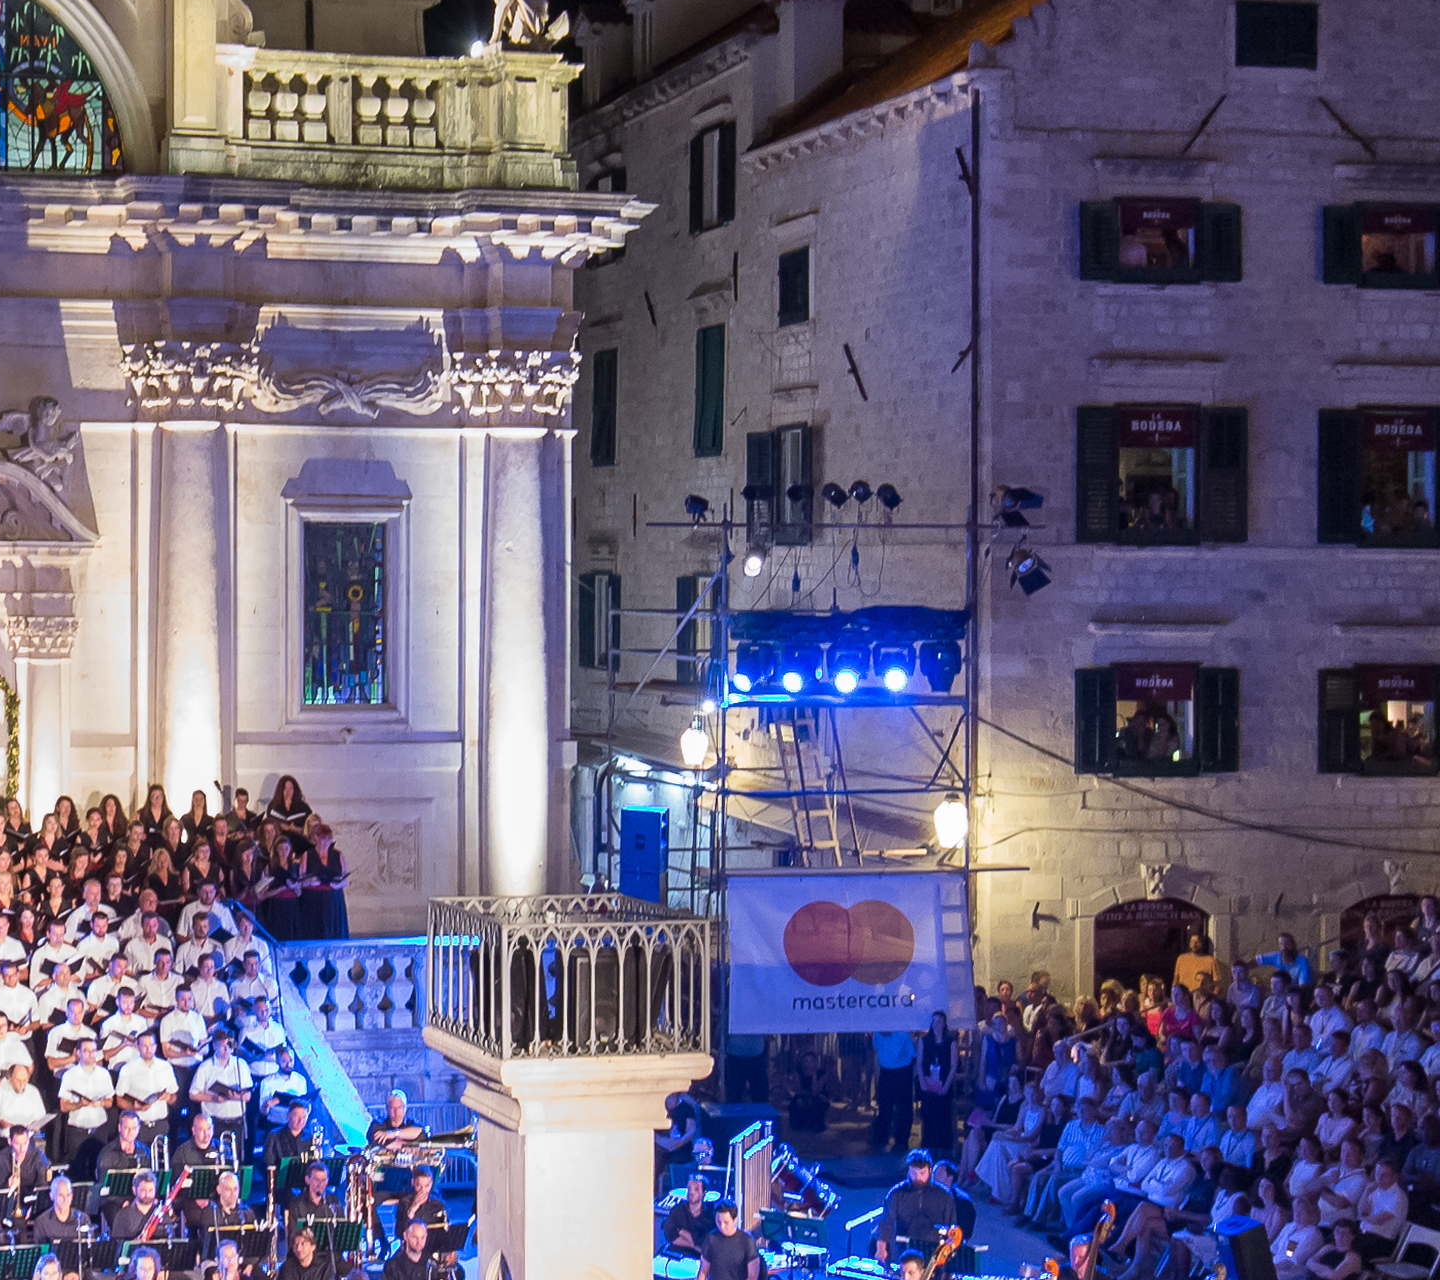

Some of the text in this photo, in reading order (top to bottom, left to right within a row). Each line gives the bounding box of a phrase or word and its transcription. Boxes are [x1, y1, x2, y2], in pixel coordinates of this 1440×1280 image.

[1131, 420, 1181, 432] BODEGA
[1374, 424, 1423, 435] BODEGA
[792, 993, 914, 1010] mastercard
